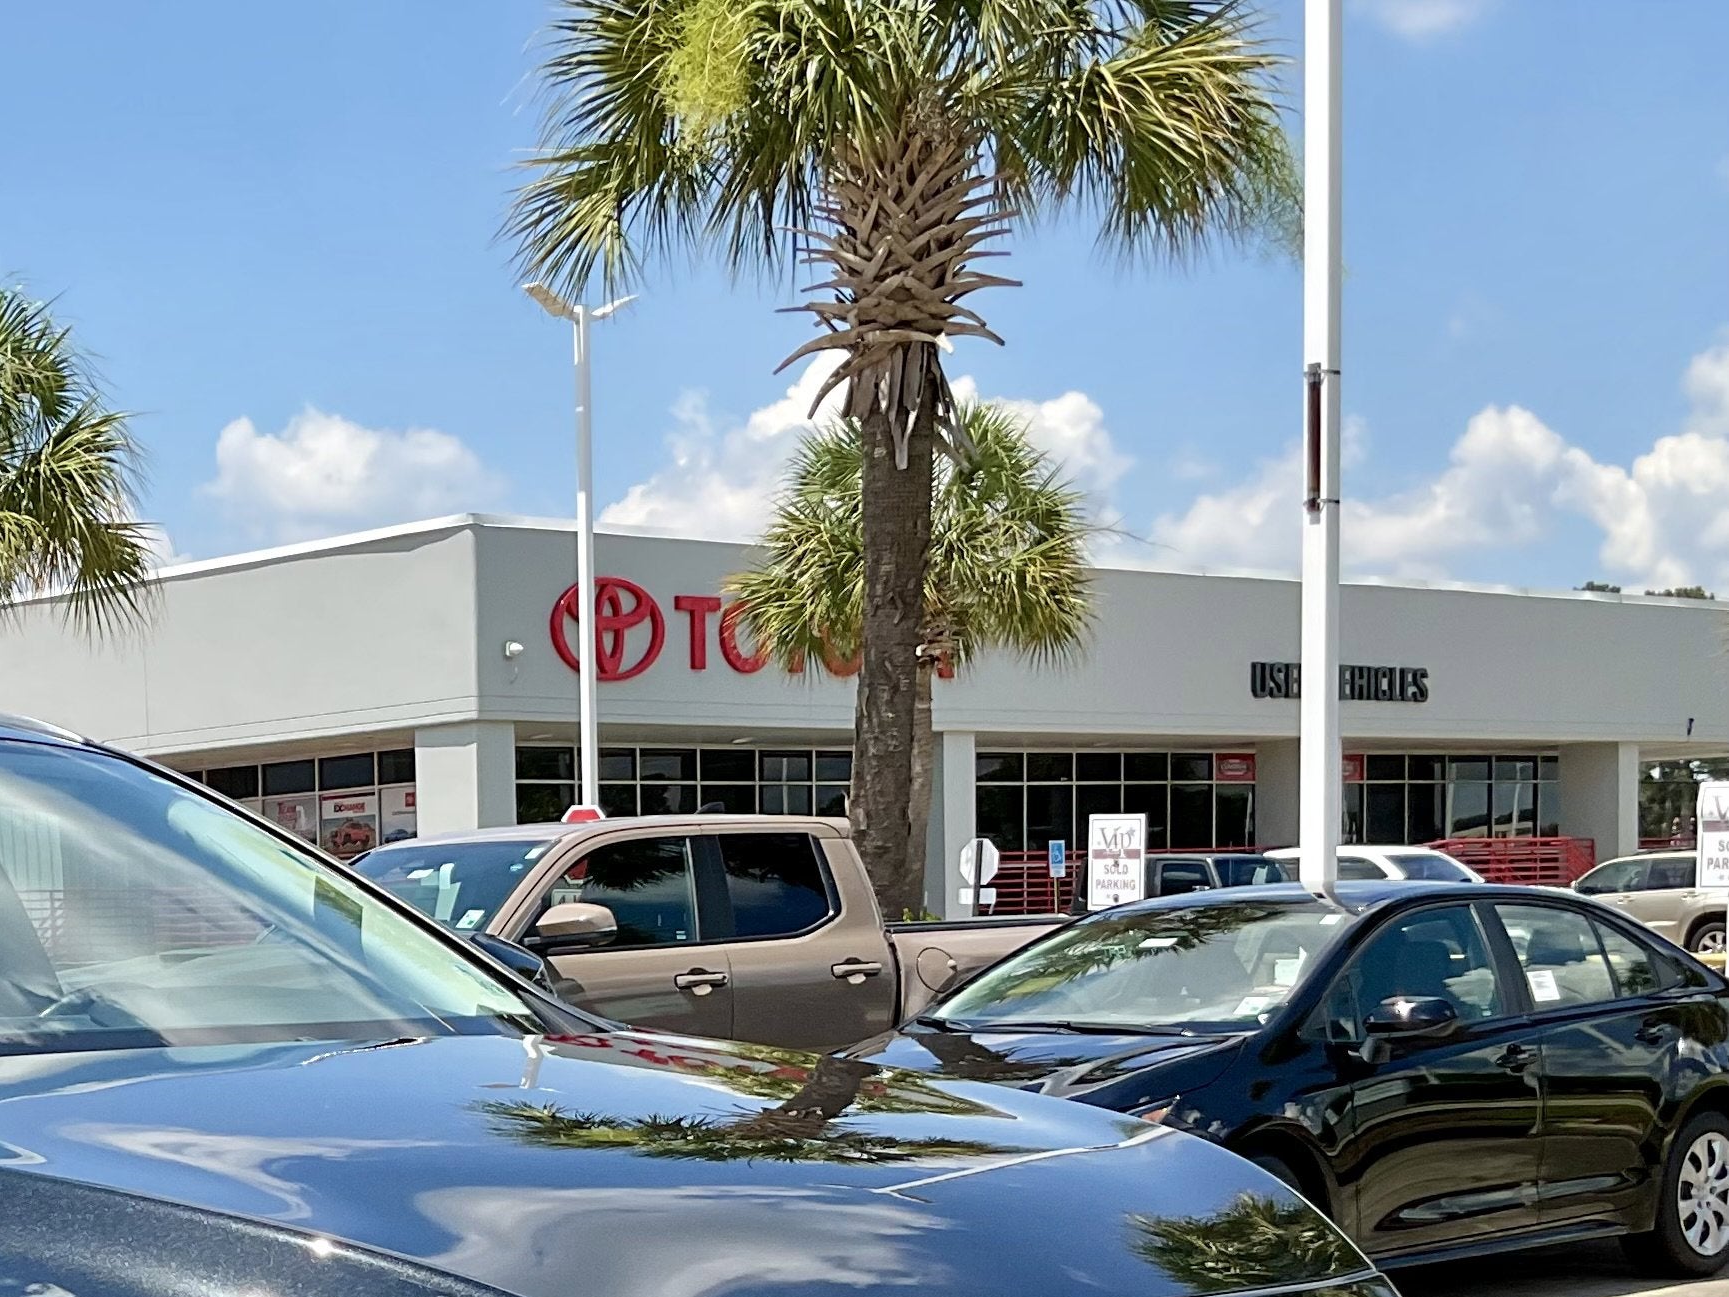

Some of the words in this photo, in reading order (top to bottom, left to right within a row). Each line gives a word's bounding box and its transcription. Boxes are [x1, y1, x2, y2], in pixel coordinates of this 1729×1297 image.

[1251, 662, 1302, 699] USE
[1339, 664, 1429, 703] EHICLES
[1104, 864, 1128, 875] SOLD
[1095, 879, 1136, 890] PARKING
